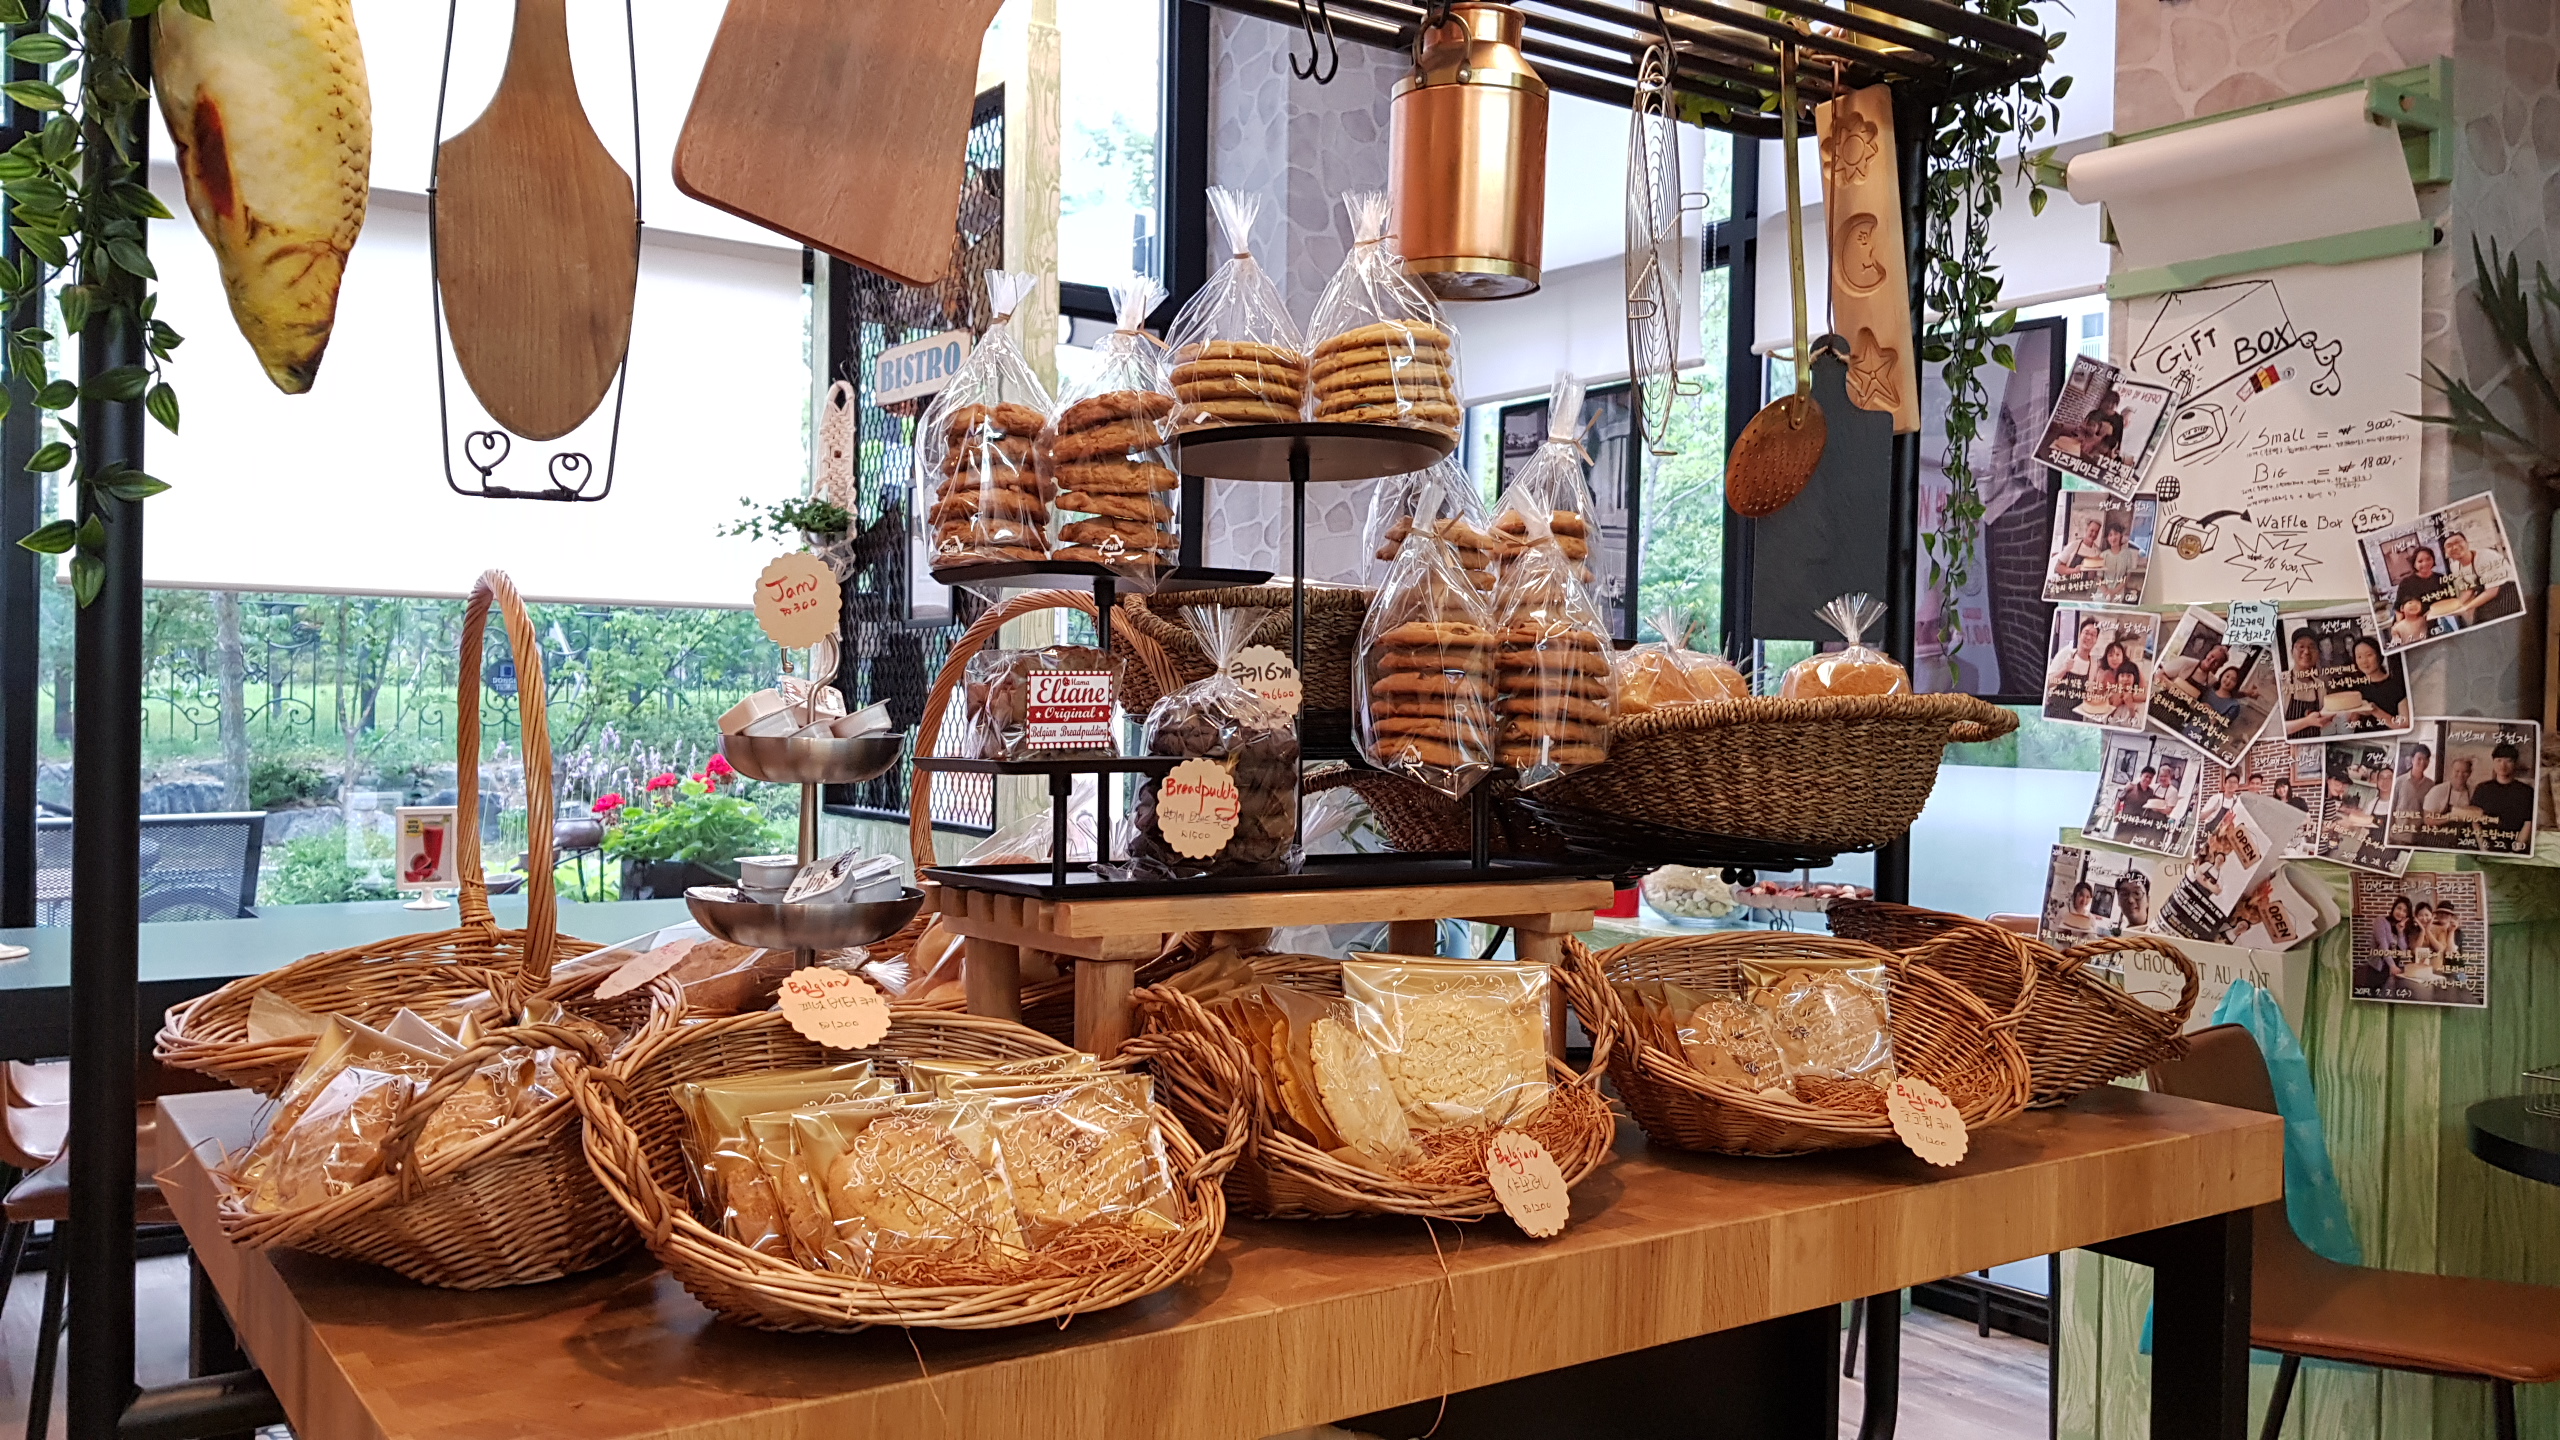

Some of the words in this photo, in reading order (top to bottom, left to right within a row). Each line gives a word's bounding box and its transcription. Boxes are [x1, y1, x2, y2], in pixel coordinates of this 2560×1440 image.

[2234, 321, 2289, 366] BOX
[881, 341, 960, 393] BISTRO
[2252, 427, 2305, 449] Small
[2049, 450, 2100, 479] 치즈케이크
[2103, 474, 2133, 494] 주인공
[2257, 514, 2308, 529] Waffle
[2317, 516, 2343, 529] Box
[765, 574, 818, 602] Jam
[2234, 602, 2258, 614] Free
[1036, 677, 1105, 704] Eliane
[1071, 678, 1090, 686] Mama
[1044, 706, 1096, 722] Original
[1031, 725, 1057, 740] Belgian
[1060, 724, 1107, 740] Breadpudding
[2448, 730, 2486, 742] 세번째
[2492, 731, 2530, 745] 당첨자
[2236, 829, 2257, 862] OPEN
[2269, 904, 2291, 940] OPEN
[788, 974, 850, 998] Belgian
[2214, 964, 2231, 985] AU
[827, 997, 858, 1009] 버터
[1896, 1084, 1948, 1112] Belgian
[1493, 1142, 1538, 1174] Belgian
